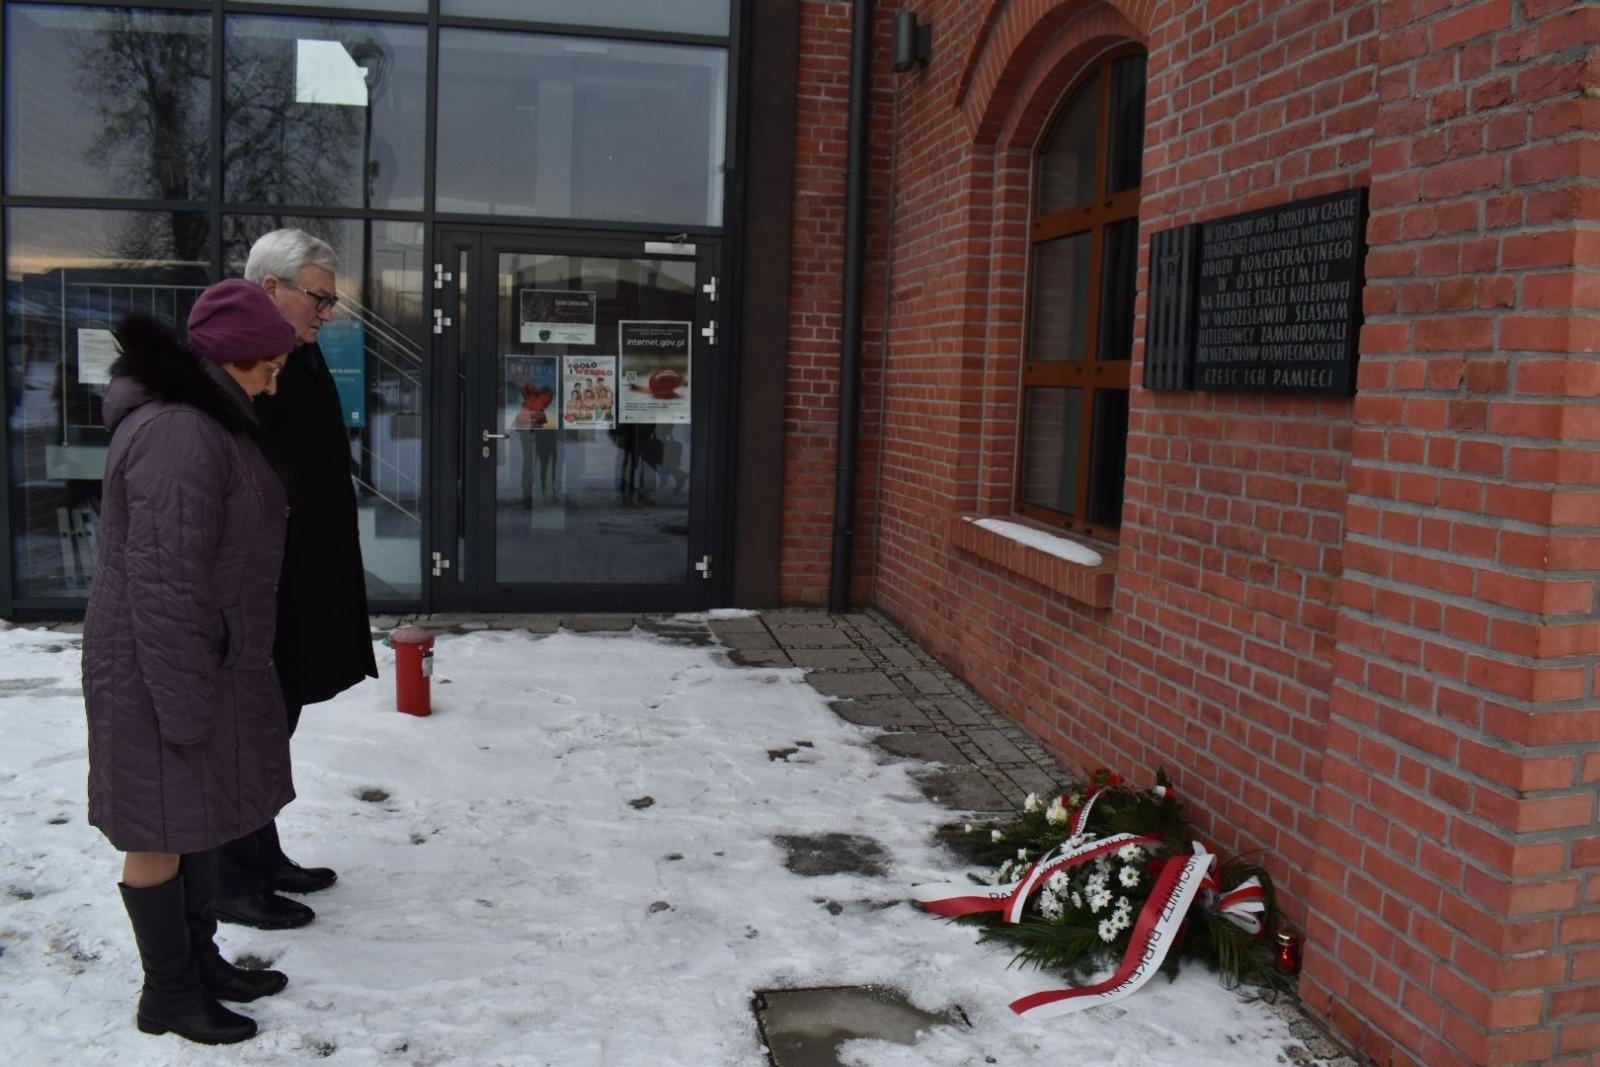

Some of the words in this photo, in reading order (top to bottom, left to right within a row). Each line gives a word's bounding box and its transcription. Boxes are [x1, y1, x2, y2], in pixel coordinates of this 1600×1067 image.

[1204, 227, 1213, 242] W
[1277, 208, 1304, 228] ROKU
[1307, 205, 1319, 222] W
[1321, 197, 1354, 219] CZASIE
[1240, 239, 1352, 271] KONCENTRACYJNEGO
[1217, 277, 1227, 290] W
[1200, 296, 1212, 309] NA
[1254, 288, 1285, 304] STACJI
[1289, 281, 1349, 301] KOLEJOWEJ
[1199, 313, 1208, 326] W
[1260, 322, 1346, 341] ZAMORDOWALI
[626, 339, 686, 347] internet.gov.pl
[1244, 370, 1265, 384] ICH
[1098, 929, 1162, 998] BIRKENAU
